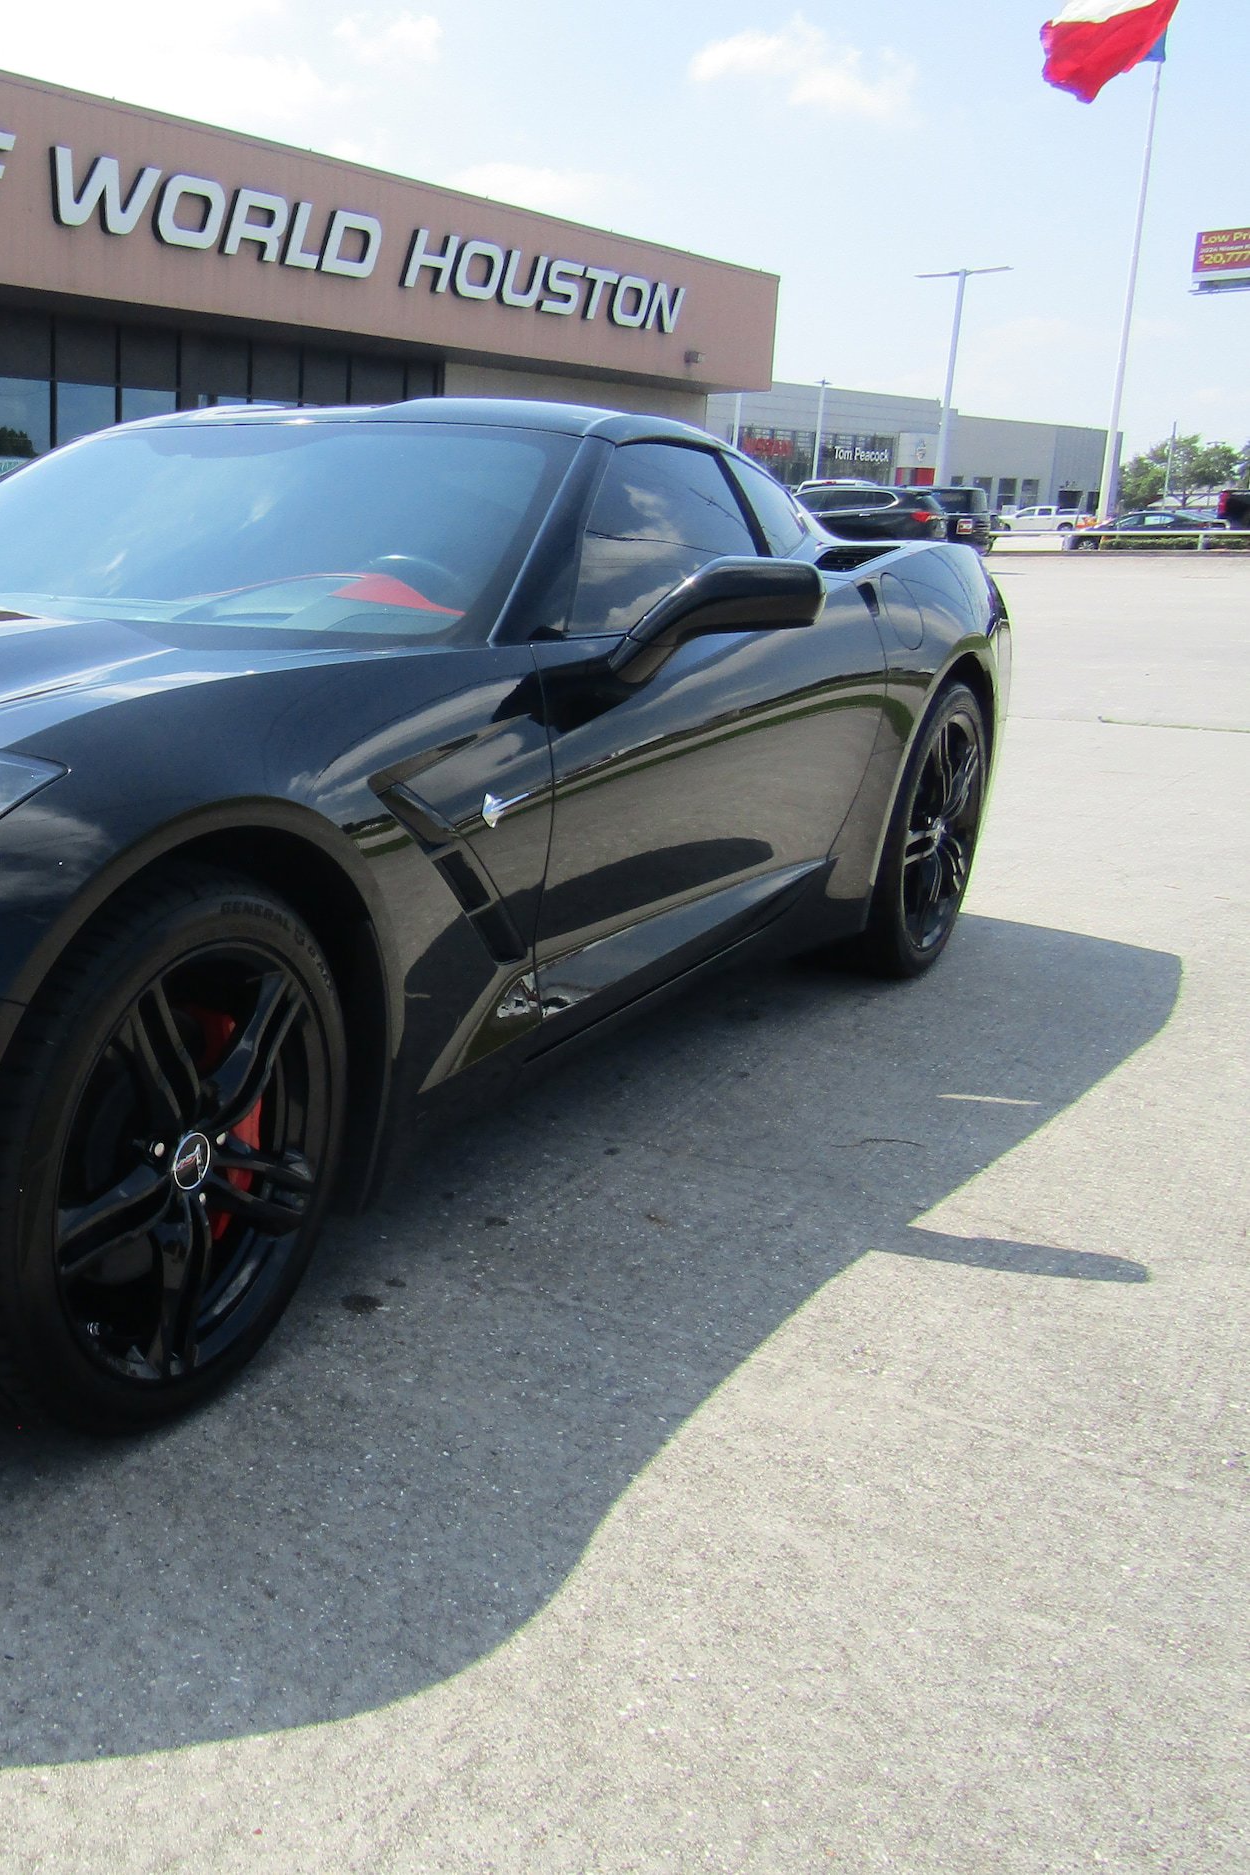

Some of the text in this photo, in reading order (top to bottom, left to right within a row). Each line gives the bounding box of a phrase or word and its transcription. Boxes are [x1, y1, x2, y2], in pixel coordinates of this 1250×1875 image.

[52, 146, 382, 280] WORLD
[402, 228, 686, 334] HOUSTON
[1201, 235, 1230, 245] Low
[834, 446, 889, 463] Tom Peacock
